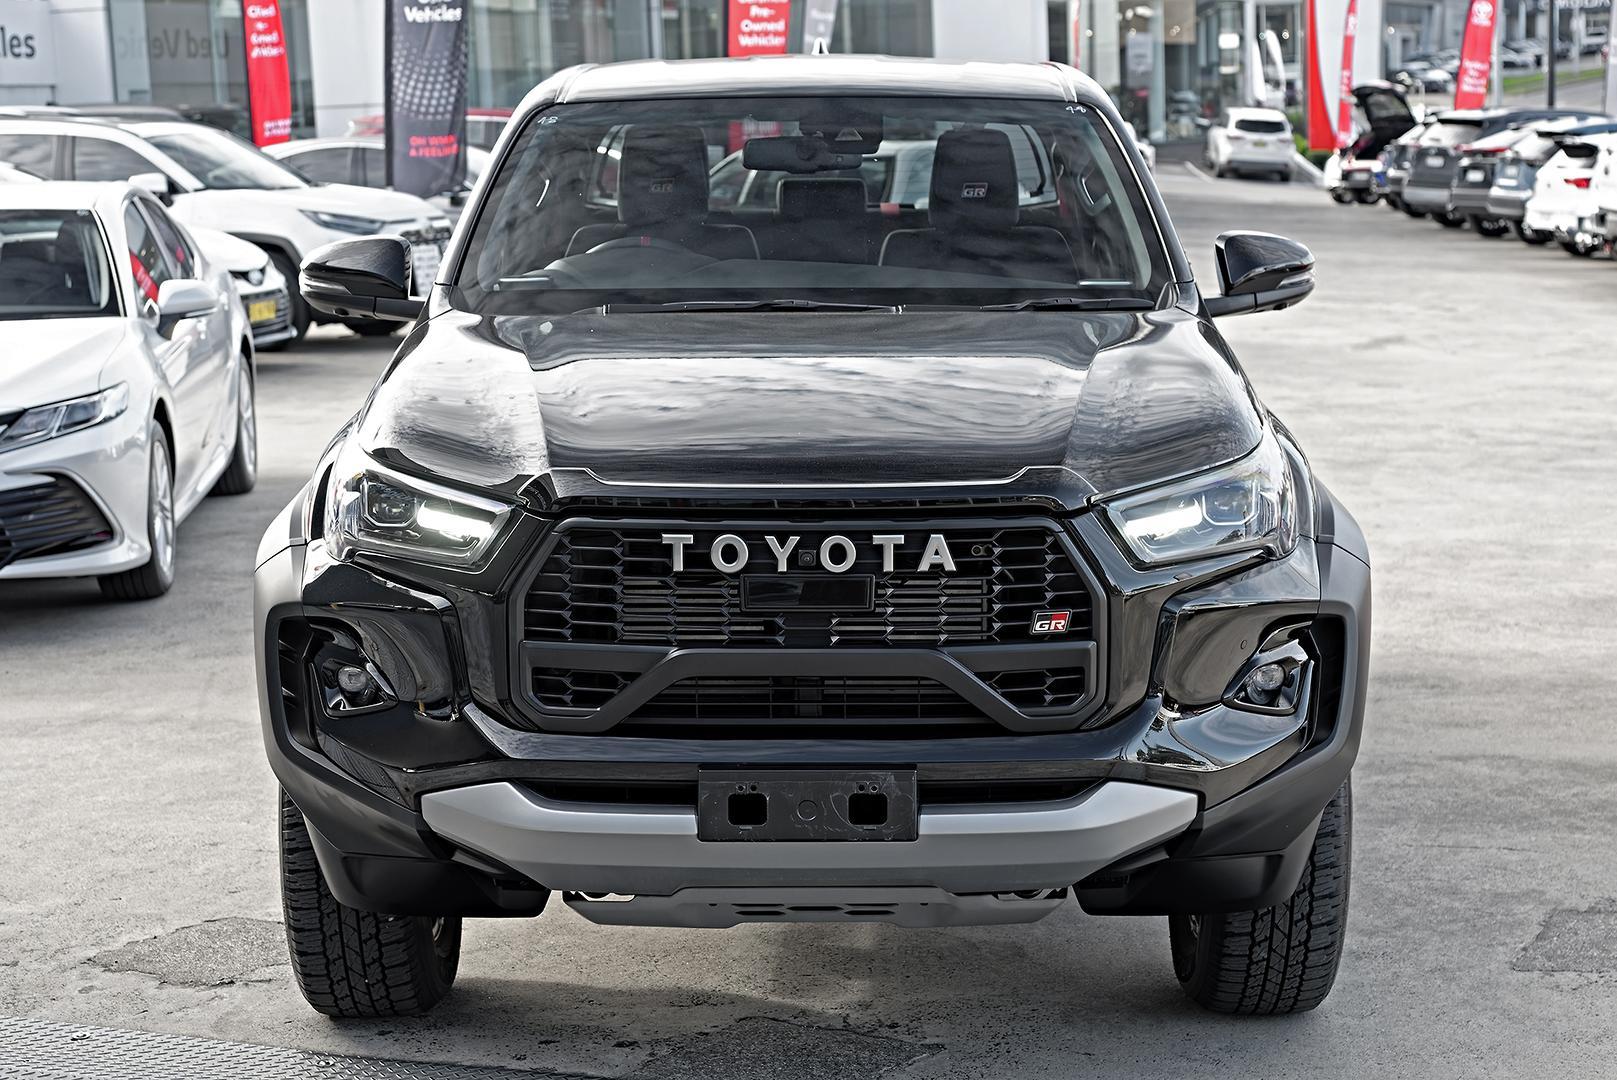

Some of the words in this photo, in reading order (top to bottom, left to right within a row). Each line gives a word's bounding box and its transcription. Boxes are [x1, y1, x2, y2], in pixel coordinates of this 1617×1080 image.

[961, 187, 986, 198] GR
[661, 533, 957, 574] TOYOTA
[1034, 618, 1066, 631] GR
